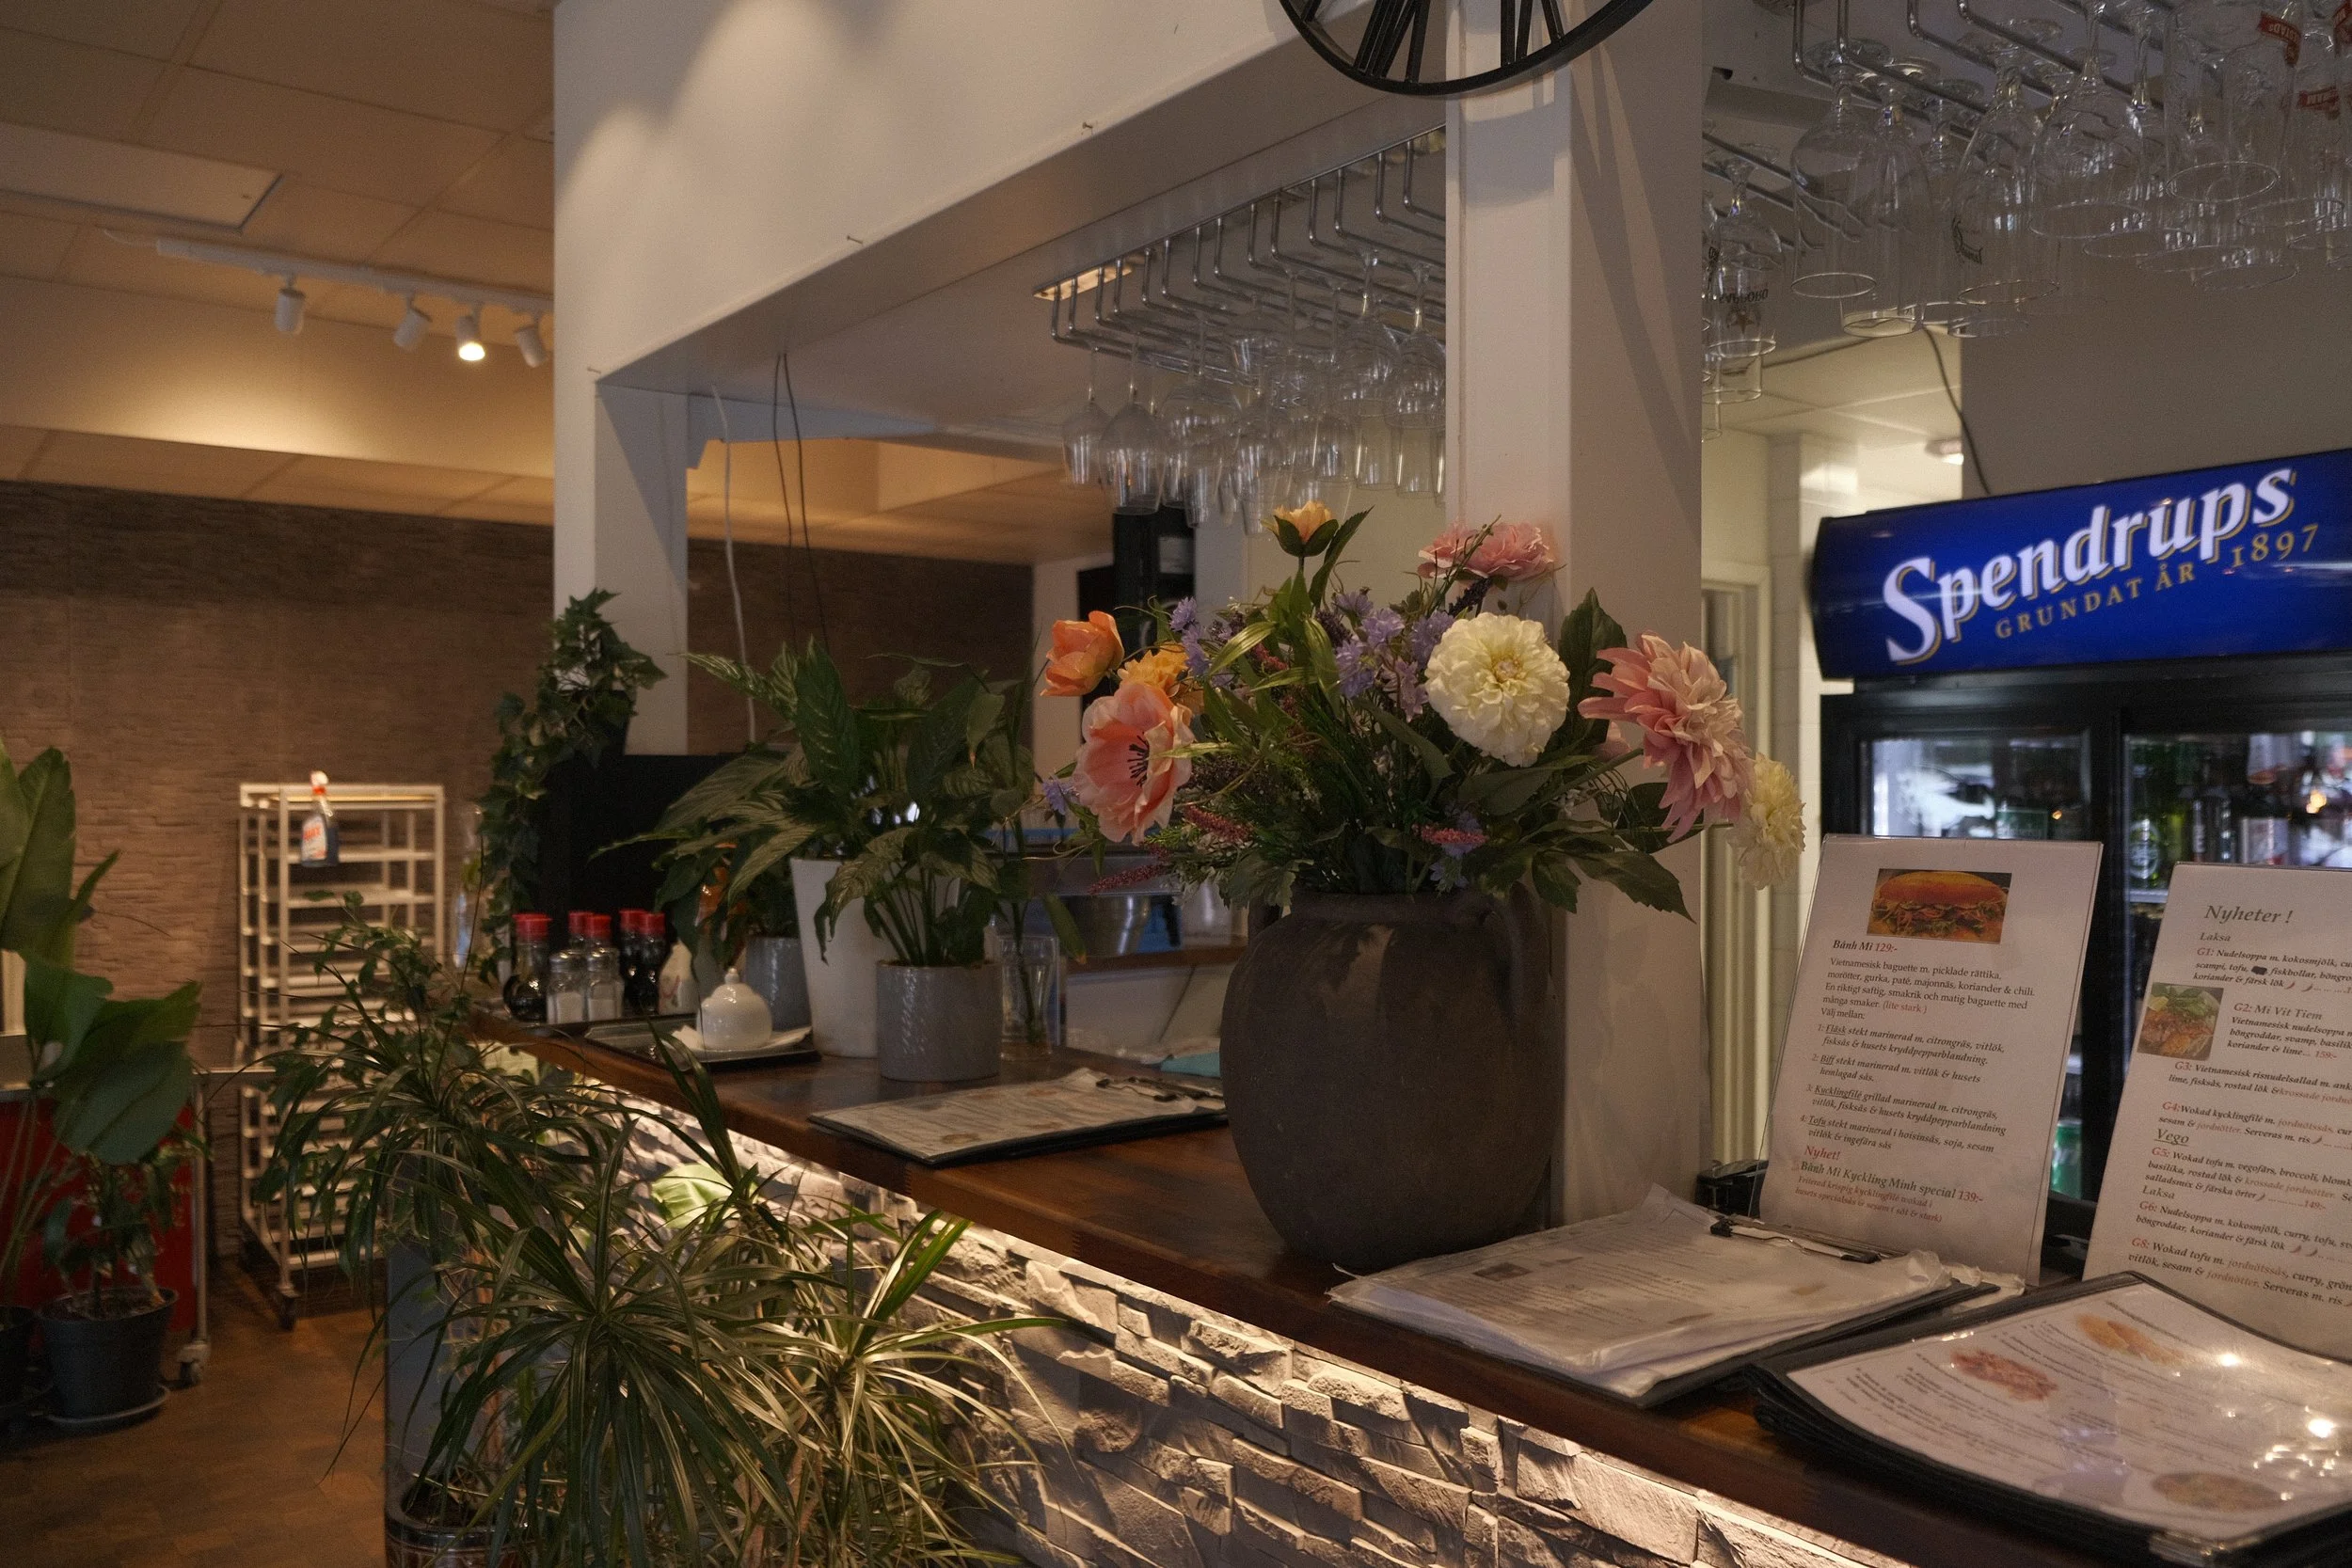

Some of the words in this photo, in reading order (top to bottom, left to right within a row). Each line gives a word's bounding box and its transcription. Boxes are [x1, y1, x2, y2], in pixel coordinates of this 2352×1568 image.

[1883, 468, 2296, 664] Spendrups
[1995, 580, 2142, 640] GRUNDAT
[2154, 559, 2196, 591] ÅR
[2230, 524, 2320, 569] 1897
[2204, 906, 2281, 925] Nyheter
[2200, 932, 2231, 942] Laksa
[1875, 942, 1898, 954] 129:-
[2217, 949, 2267, 963] Nudelsoppa
[2282, 955, 2338, 968] kokosmjölk,
[1831, 958, 1881, 970] Vietnamesisk
[1883, 962, 1917, 974] baguette
[1932, 967, 1968, 976] picklade
[2269, 966, 2316, 979] fiskbollar,
[1827, 972, 1862, 982] morötter,
[1864, 974, 1890, 985] gurka,
[1915, 979, 1956, 990] majonnäs,
[1959, 982, 2002, 993] koriander
[2193, 971, 2233, 982] koriander
[2245, 975, 2267, 986] färsk
[2270, 978, 2284, 987] lök
[1823, 995, 1848, 1006] många
[1850, 999, 1880, 1008] smaker.
[1825, 982, 1835, 990] En
[1837, 984, 1861, 995] riktigt
[1862, 987, 1886, 998] saftig,
[1888, 990, 1921, 999] smakrik
[1924, 992, 1938, 1001] och
[1941, 995, 1964, 1006] matig
[1967, 996, 2006, 1007] baguette
[2008, 1001, 2027, 1009] med
[1821, 1007, 1836, 1019] Välj
[2233, 1003, 2251, 1013] G2:
[2275, 1007, 2291, 1017] Vit
[2295, 1009, 2323, 1020] Tiem
[2232, 1015, 2289, 1029] Vietnamesisk
[2292, 1023, 2344, 1037] nudelsoppa
[1821, 1037, 1850, 1048] fisksås
[1861, 1041, 1886, 1053] husets
[1825, 1024, 1846, 1037] Fläsk
[1848, 1028, 1868, 1037] stekt
[1869, 1032, 1913, 1042] marinerad
[1926, 1037, 1972, 1051] citrongräs,
[2227, 1038, 2270, 1052] koriander
[2230, 1027, 2282, 1042] böngroddar,
[2284, 1036, 2317, 1047] svamp,
[1820, 1054, 1835, 1067] Biff
[1836, 1057, 1855, 1067] stekt
[1857, 1062, 1899, 1072] marinerad
[1914, 1068, 1939, 1078] vitlök
[1952, 1071, 1981, 1084] husets
[1820, 1067, 1857, 1081] hemlagad
[1858, 1073, 1874, 1082] sås.
[2195, 1064, 2251, 1078] Vietnamesisk
[2252, 1071, 2318, 1086] risnudelsallad
[2169, 1072, 2188, 1085] lime,
[2189, 1075, 2222, 1089] fisksås,
[2224, 1083, 2252, 1092] rostad
[2254, 1084, 2268, 1094] lök
[1814, 1085, 1863, 1101] Kycklingfilé
[1862, 1093, 1891, 1103] grillad
[1893, 1099, 1936, 1110] marinerad
[1951, 1106, 1998, 1120] citrongräs,
[1812, 1098, 1837, 1109] vitlök,
[1836, 1101, 1867, 1113] fisksås
[1879, 1107, 1905, 1118] husets
[1906, 1111, 2007, 1136] kryddpepparblandning
[1808, 1116, 1826, 1128] Tofu
[1828, 1119, 1849, 1130] stekt
[1850, 1125, 1892, 1136] marinerad
[1899, 1130, 1941, 1146] hoisinsås,
[1944, 1139, 1964, 1149] soja,
[1966, 1143, 1994, 1152] sesam
[1808, 1130, 1832, 1139] vitlök
[1843, 1134, 1876, 1147] ingefära
[1878, 1140, 1892, 1148] sås
[2154, 1129, 2189, 1147] Vego
[2158, 1117, 2185, 1125] sesam
[2245, 1127, 2282, 1140] Serveras
[2297, 1135, 2311, 1144] ris
[1804, 1146, 1841, 1161] Nyhet!
[2148, 1160, 2185, 1175] basilika,
[2188, 1168, 2217, 1179] rostad
[2218, 1171, 2233, 1181] lök
[2173, 1151, 2204, 1164] Wokad
[2205, 1156, 2223, 1168] tofu
[2280, 1168, 2319, 1183] broccoli,
[1828, 1181, 1853, 1196] krispig
[1843, 1169, 1887, 1189] Kyckling
[1888, 1179, 1917, 1192] Minh
[1919, 1186, 1957, 1199] special
[1958, 1191, 1983, 1203] 139:-
[2142, 1185, 2175, 1199] Laksa
[2145, 1173, 2193, 1187] salladsmix
[2203, 1181, 2233, 1194] färska
[2235, 1187, 2257, 1198] örter
[2136, 1214, 2187, 1233] böngroddar,
[2190, 1225, 2235, 1241] koriander
[2244, 1235, 2267, 1247] färsk
[2270, 1240, 2285, 1250] lök
[2160, 1205, 2212, 1224] Nudelsoppa
[2283, 1230, 2311, 1242] curry,
[2153, 1243, 2188, 1257] Wokad
[2190, 1250, 2211, 1263] tofu
[2292, 1274, 2325, 1287] curry,
[2162, 1261, 2192, 1273] sesam
[2264, 1280, 2309, 1298] Serveras
[2328, 1295, 2343, 1305] ris
